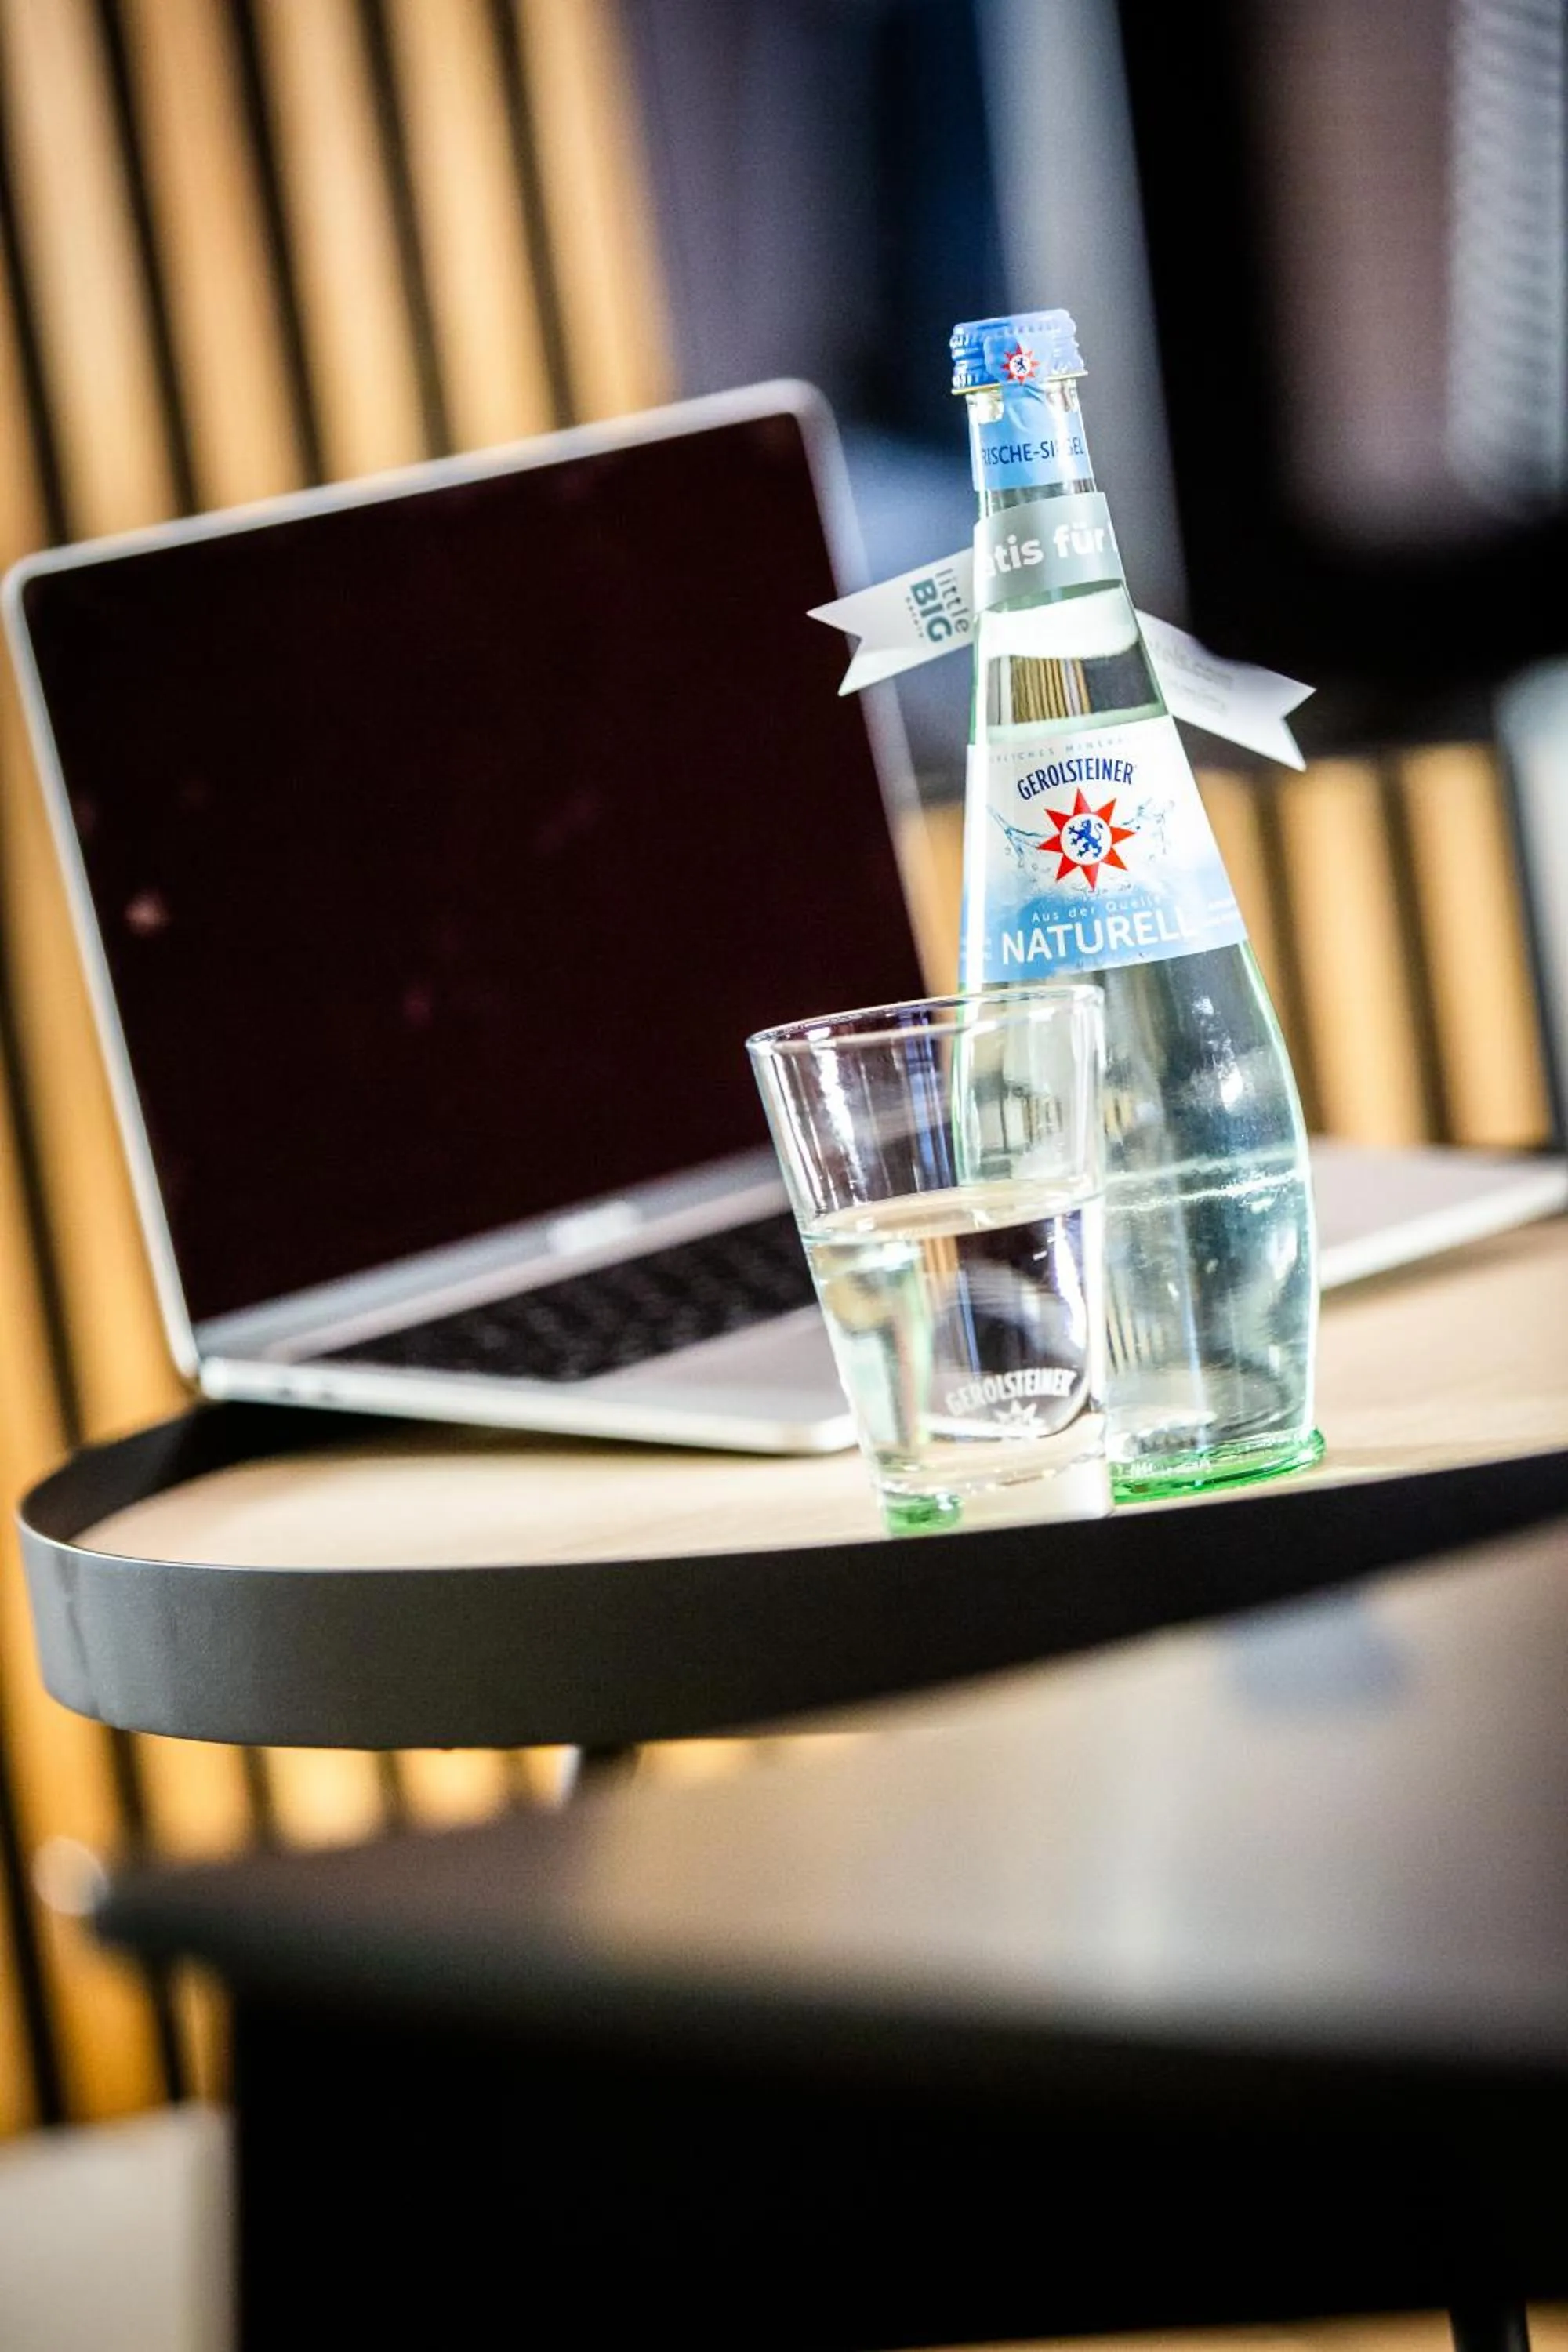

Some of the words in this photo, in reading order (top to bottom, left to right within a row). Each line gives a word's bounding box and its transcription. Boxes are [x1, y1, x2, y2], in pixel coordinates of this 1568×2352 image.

[1053, 522, 1104, 558] für
[910, 577, 953, 643] BIG
[935, 568, 970, 633] little
[1017, 757, 1134, 800] GEROLSTEINER
[1001, 905, 1199, 965] NATURELL
[1032, 910, 1059, 924] Aus
[1069, 904, 1096, 919] der
[946, 1367, 1077, 1417] GEROLSTEINER
